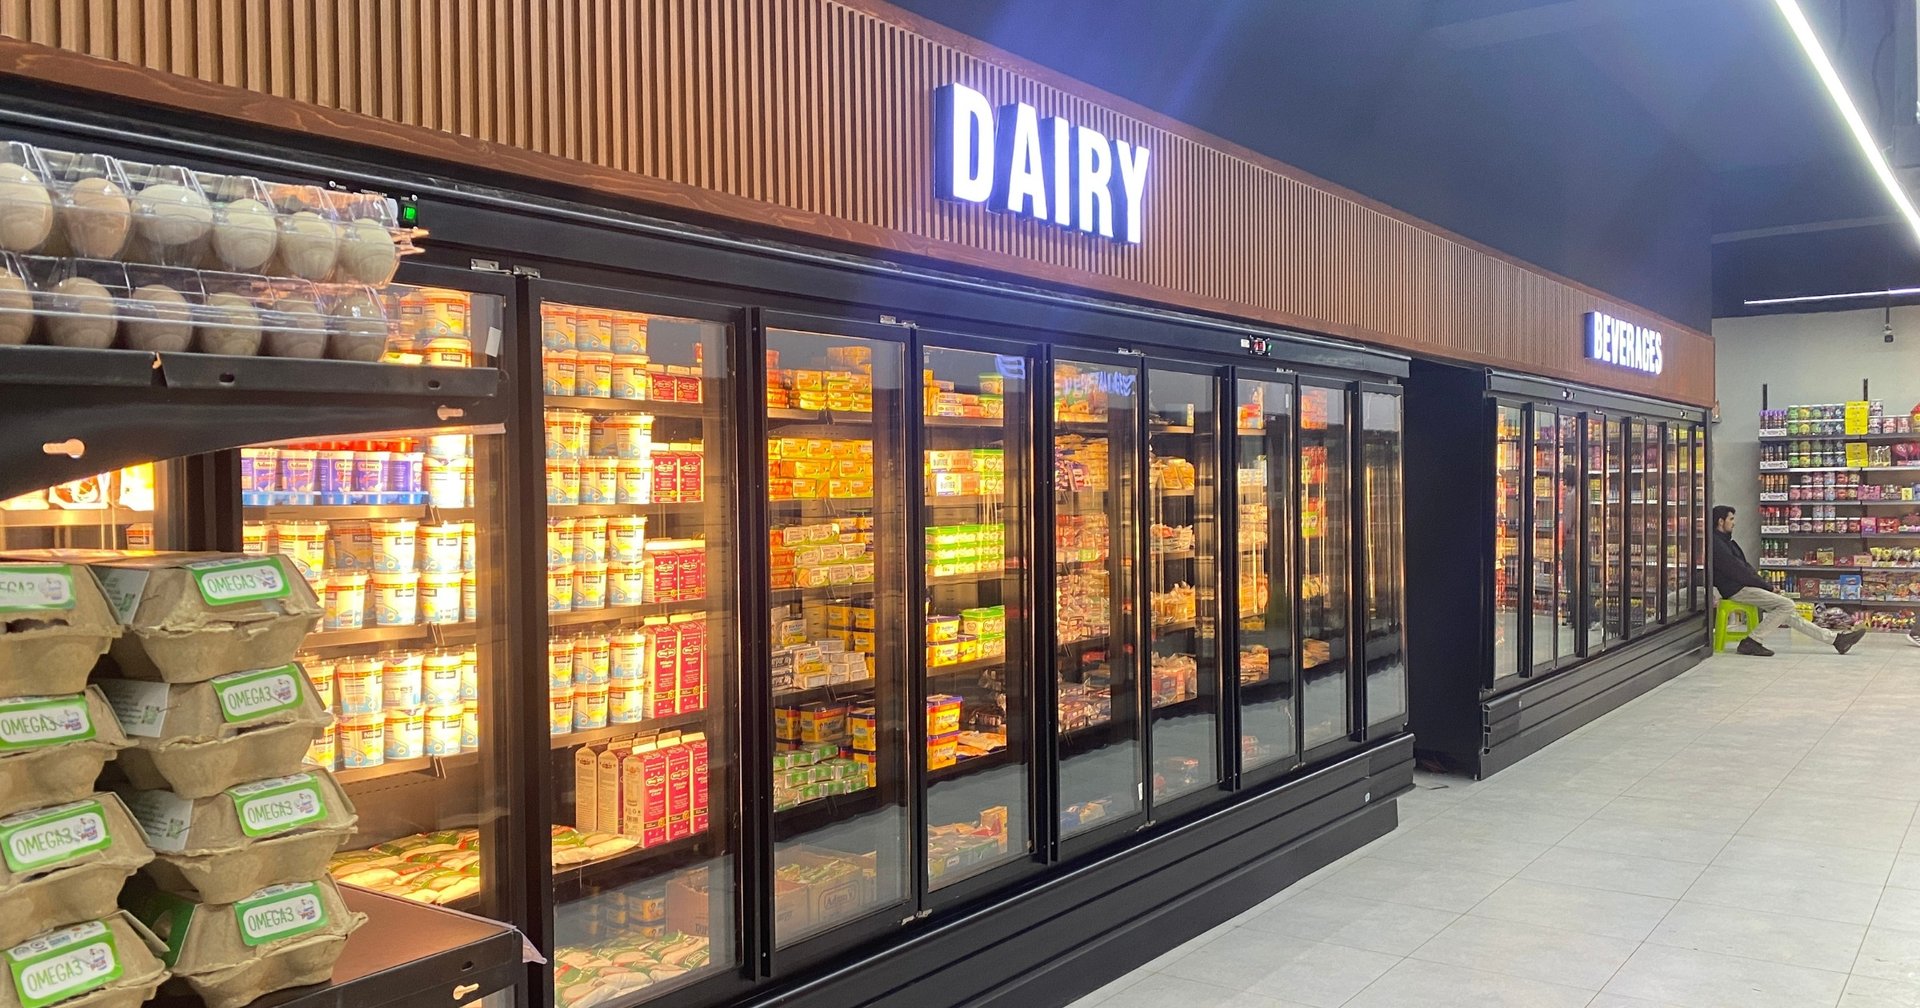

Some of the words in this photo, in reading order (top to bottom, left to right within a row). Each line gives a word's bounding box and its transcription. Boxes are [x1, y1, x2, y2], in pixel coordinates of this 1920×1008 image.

[952, 82, 1150, 244] DAIRY
[1593, 311, 1663, 375] BEVERAGES
[207, 574, 257, 593] OMEGA3
[227, 686, 273, 710] OMEGA3
[1, 716, 57, 736] OMEGA3
[247, 800, 294, 824] OMEGA3
[15, 827, 73, 858] OMEGA3
[247, 907, 295, 932] OMEGA3
[26, 959, 84, 992] OMEGA3
